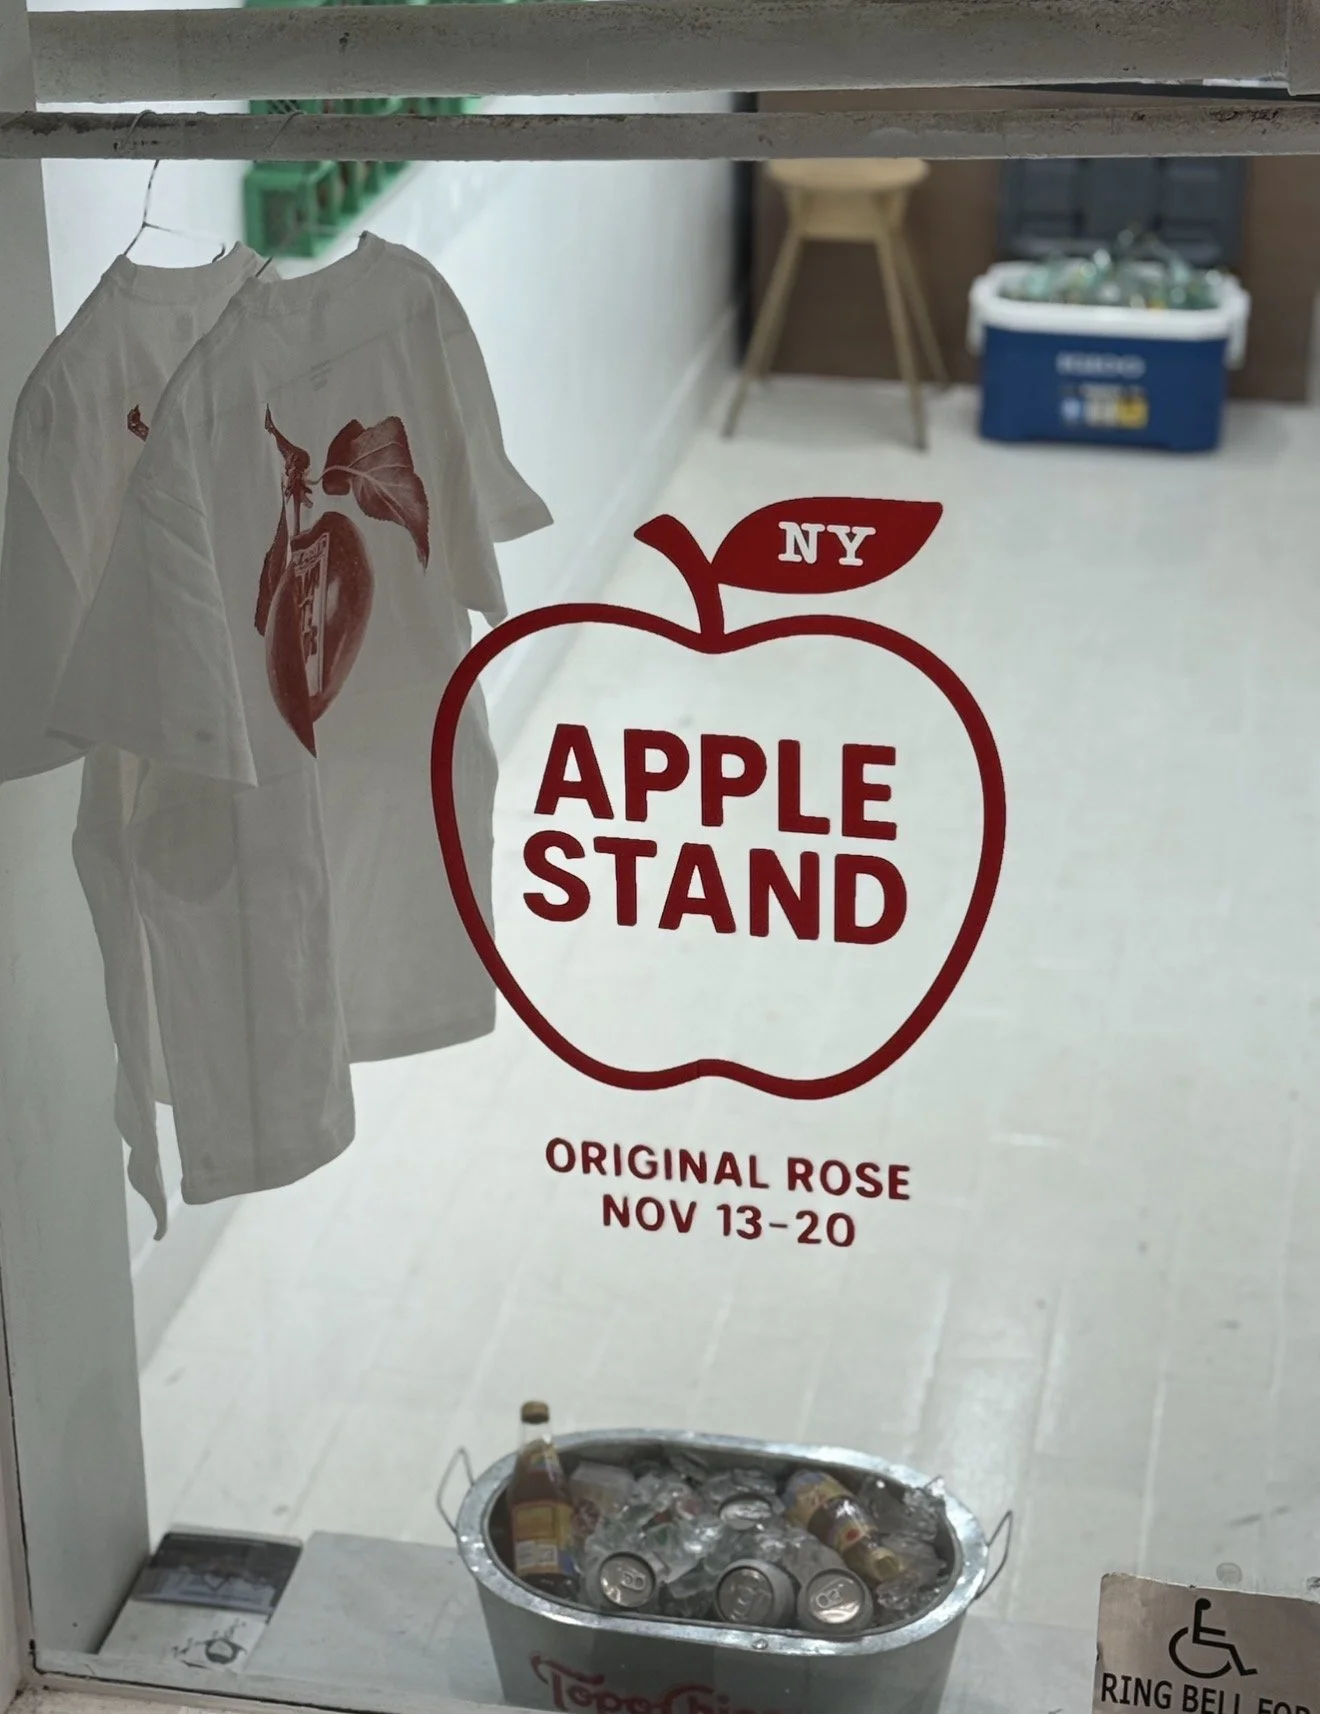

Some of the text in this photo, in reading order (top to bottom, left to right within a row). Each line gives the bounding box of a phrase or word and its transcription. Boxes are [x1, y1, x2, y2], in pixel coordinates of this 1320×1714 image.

[779, 521, 877, 567] NY
[535, 724, 898, 841] APPLE
[523, 830, 908, 945] STAND
[545, 1137, 911, 1201] ORIGINAL ROSE
[602, 1193, 697, 1234] NOV
[529, 1652, 654, 1714] Topo
[1100, 1672, 1173, 1710] RING
[1182, 1683, 1241, 1714] BELL
